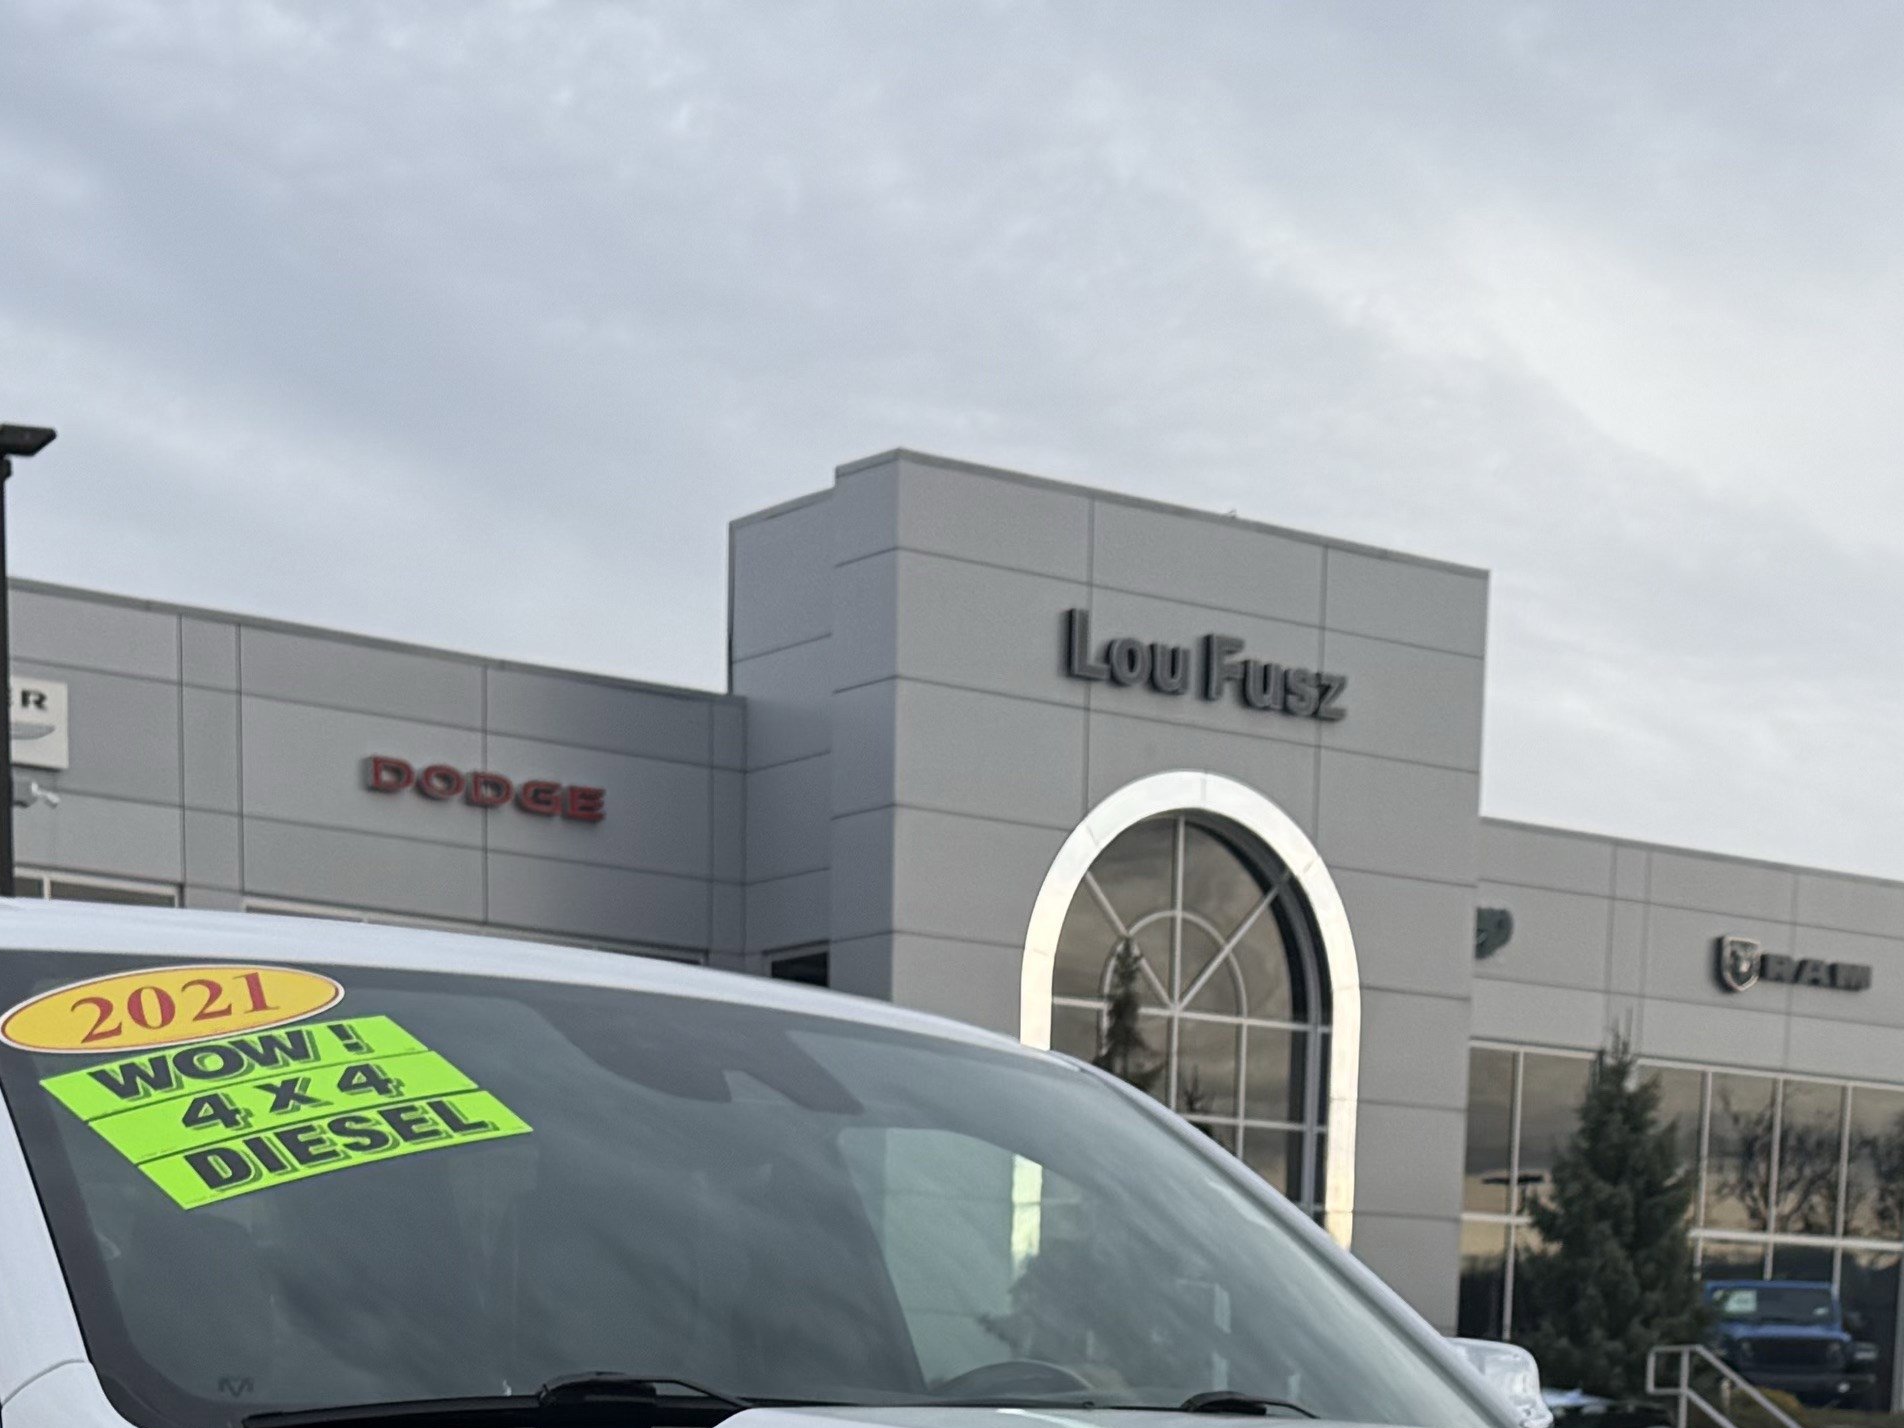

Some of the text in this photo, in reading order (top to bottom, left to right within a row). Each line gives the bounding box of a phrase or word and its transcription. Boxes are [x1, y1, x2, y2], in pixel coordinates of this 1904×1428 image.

[1064, 608, 1191, 696] Lou
[368, 755, 606, 822] DODGE
[70, 971, 280, 1043] 2021
[1761, 953, 1871, 991] RAM
[185, 1099, 499, 1190] DIESEL
